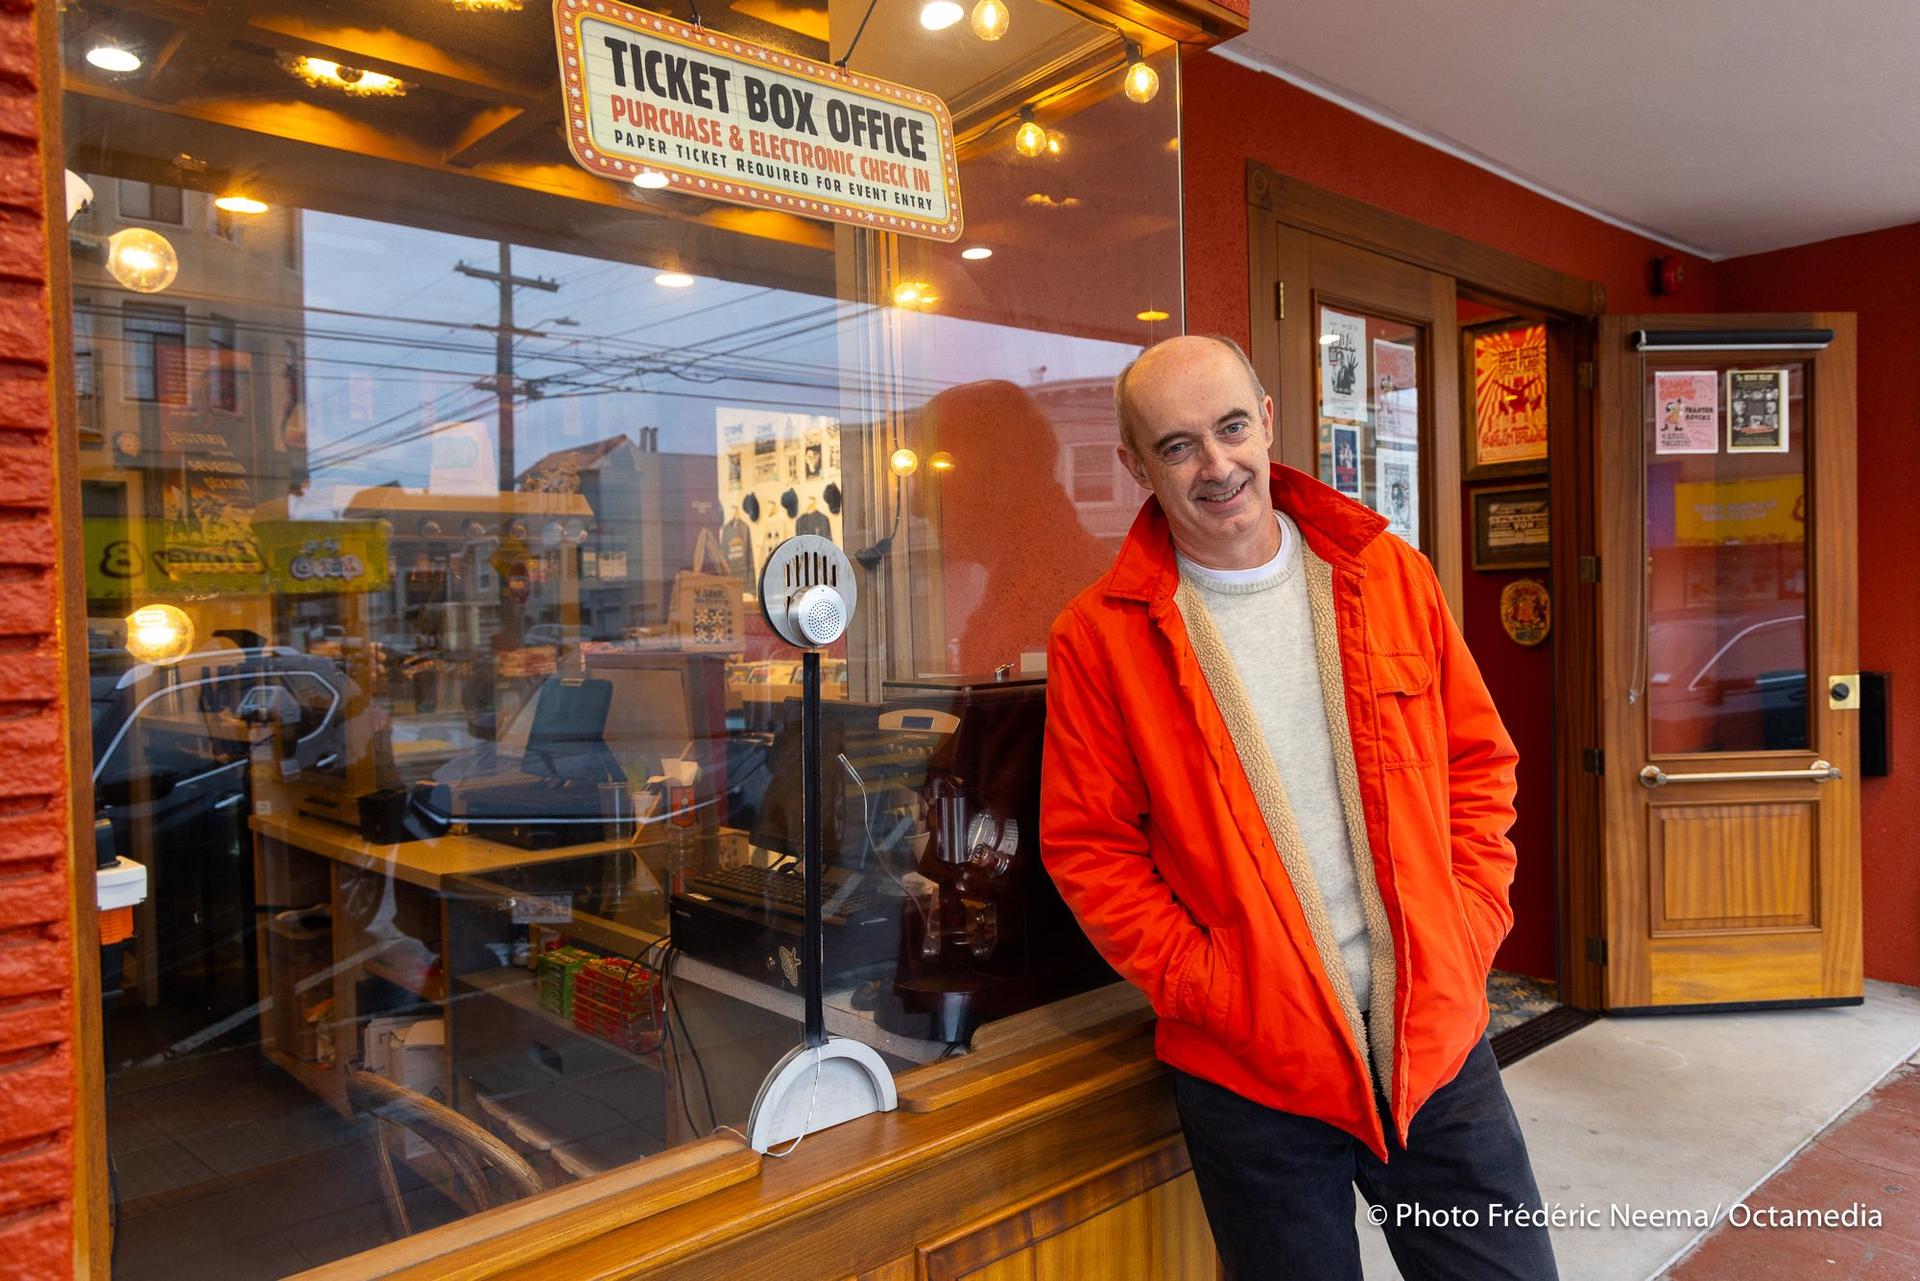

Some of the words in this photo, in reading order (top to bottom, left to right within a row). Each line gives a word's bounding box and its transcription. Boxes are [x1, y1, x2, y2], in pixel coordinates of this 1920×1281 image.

[604, 36, 731, 114] TICKET
[744, 75, 818, 136] BOX
[827, 98, 927, 162] OFFICE
[611, 94, 723, 148] PURCHASE
[728, 124, 745, 152] &
[749, 129, 856, 177] ELECTRONIC
[860, 156, 909, 189] CHECK
[913, 167, 931, 193] IN
[614, 129, 667, 155] PAPER
[676, 144, 727, 168] TICKET
[736, 158, 809, 186] REQUIRED
[816, 175, 842, 193] FOR
[849, 183, 888, 202] EVENT
[894, 192, 932, 211] ENTRY
